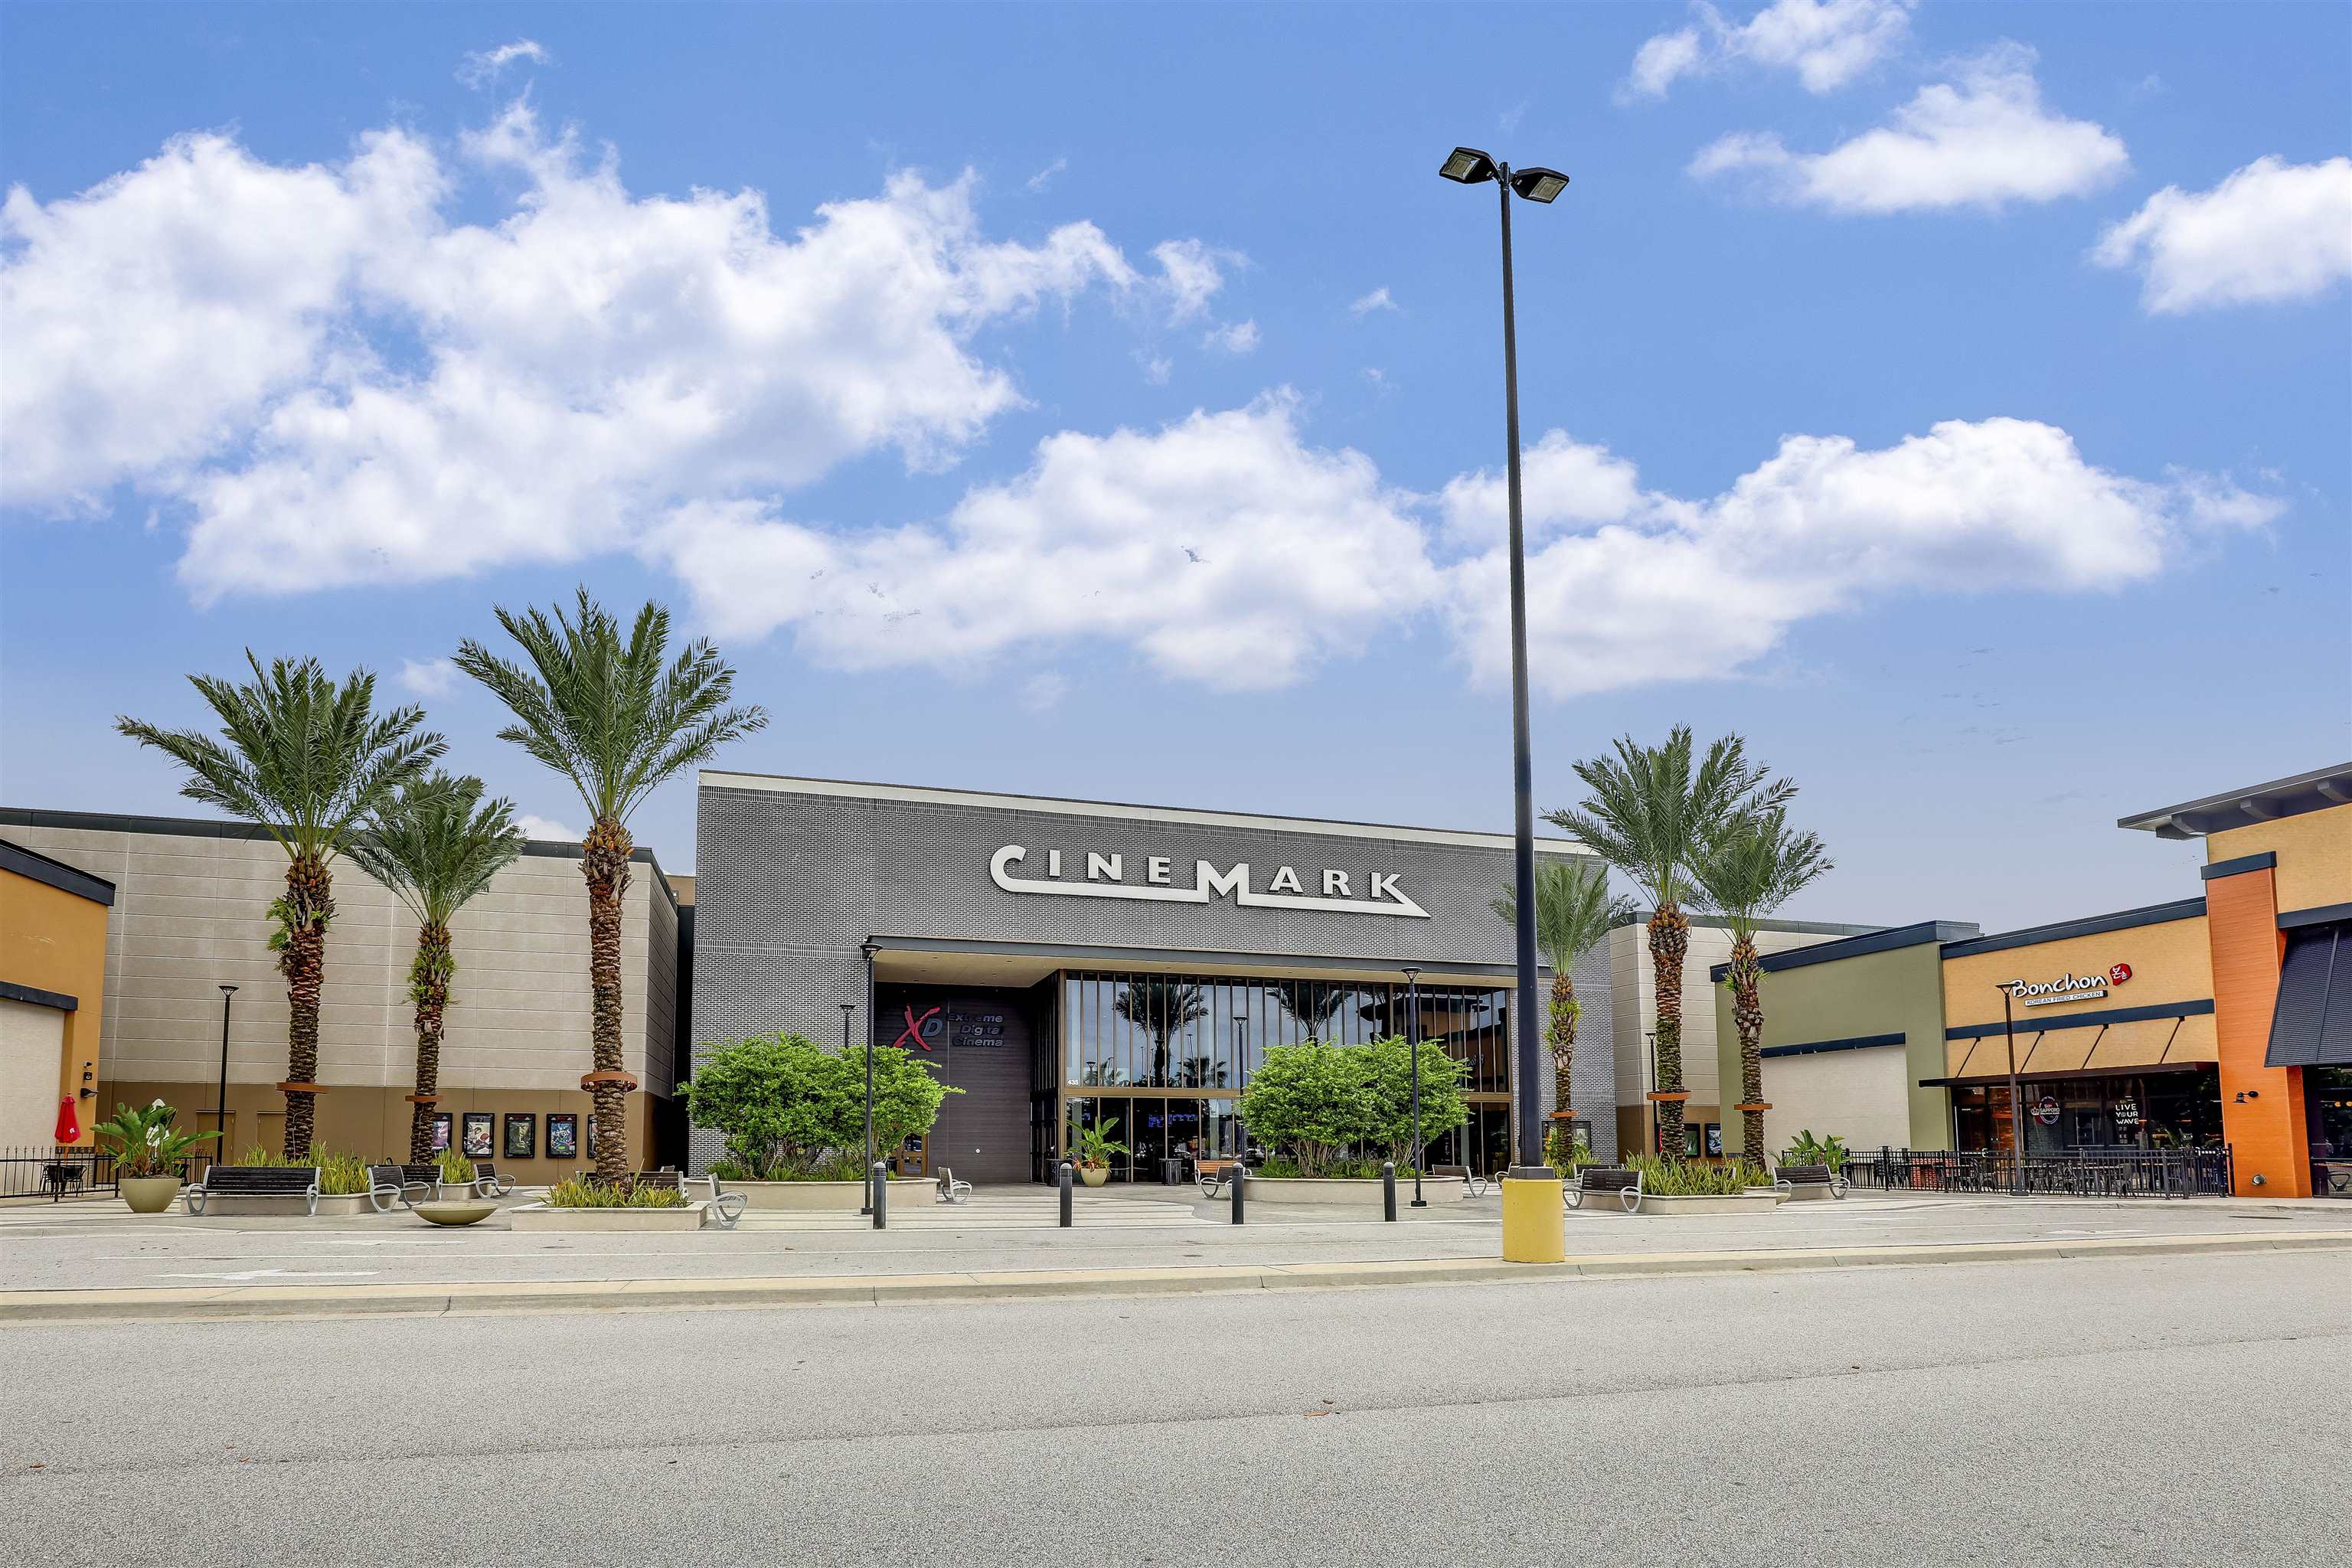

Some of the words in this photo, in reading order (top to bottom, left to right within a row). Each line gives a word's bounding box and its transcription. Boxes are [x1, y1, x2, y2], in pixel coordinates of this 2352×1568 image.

[990, 844, 1432, 918] CINEMARK
[2011, 973, 2106, 998] Bonchon
[2073, 991, 2101, 1000] CHICKEN
[949, 1012, 1004, 1022] Exteme
[894, 1005, 943, 1051] XD
[961, 1024, 1002, 1035] Digta
[952, 1037, 1003, 1046] Cinema
